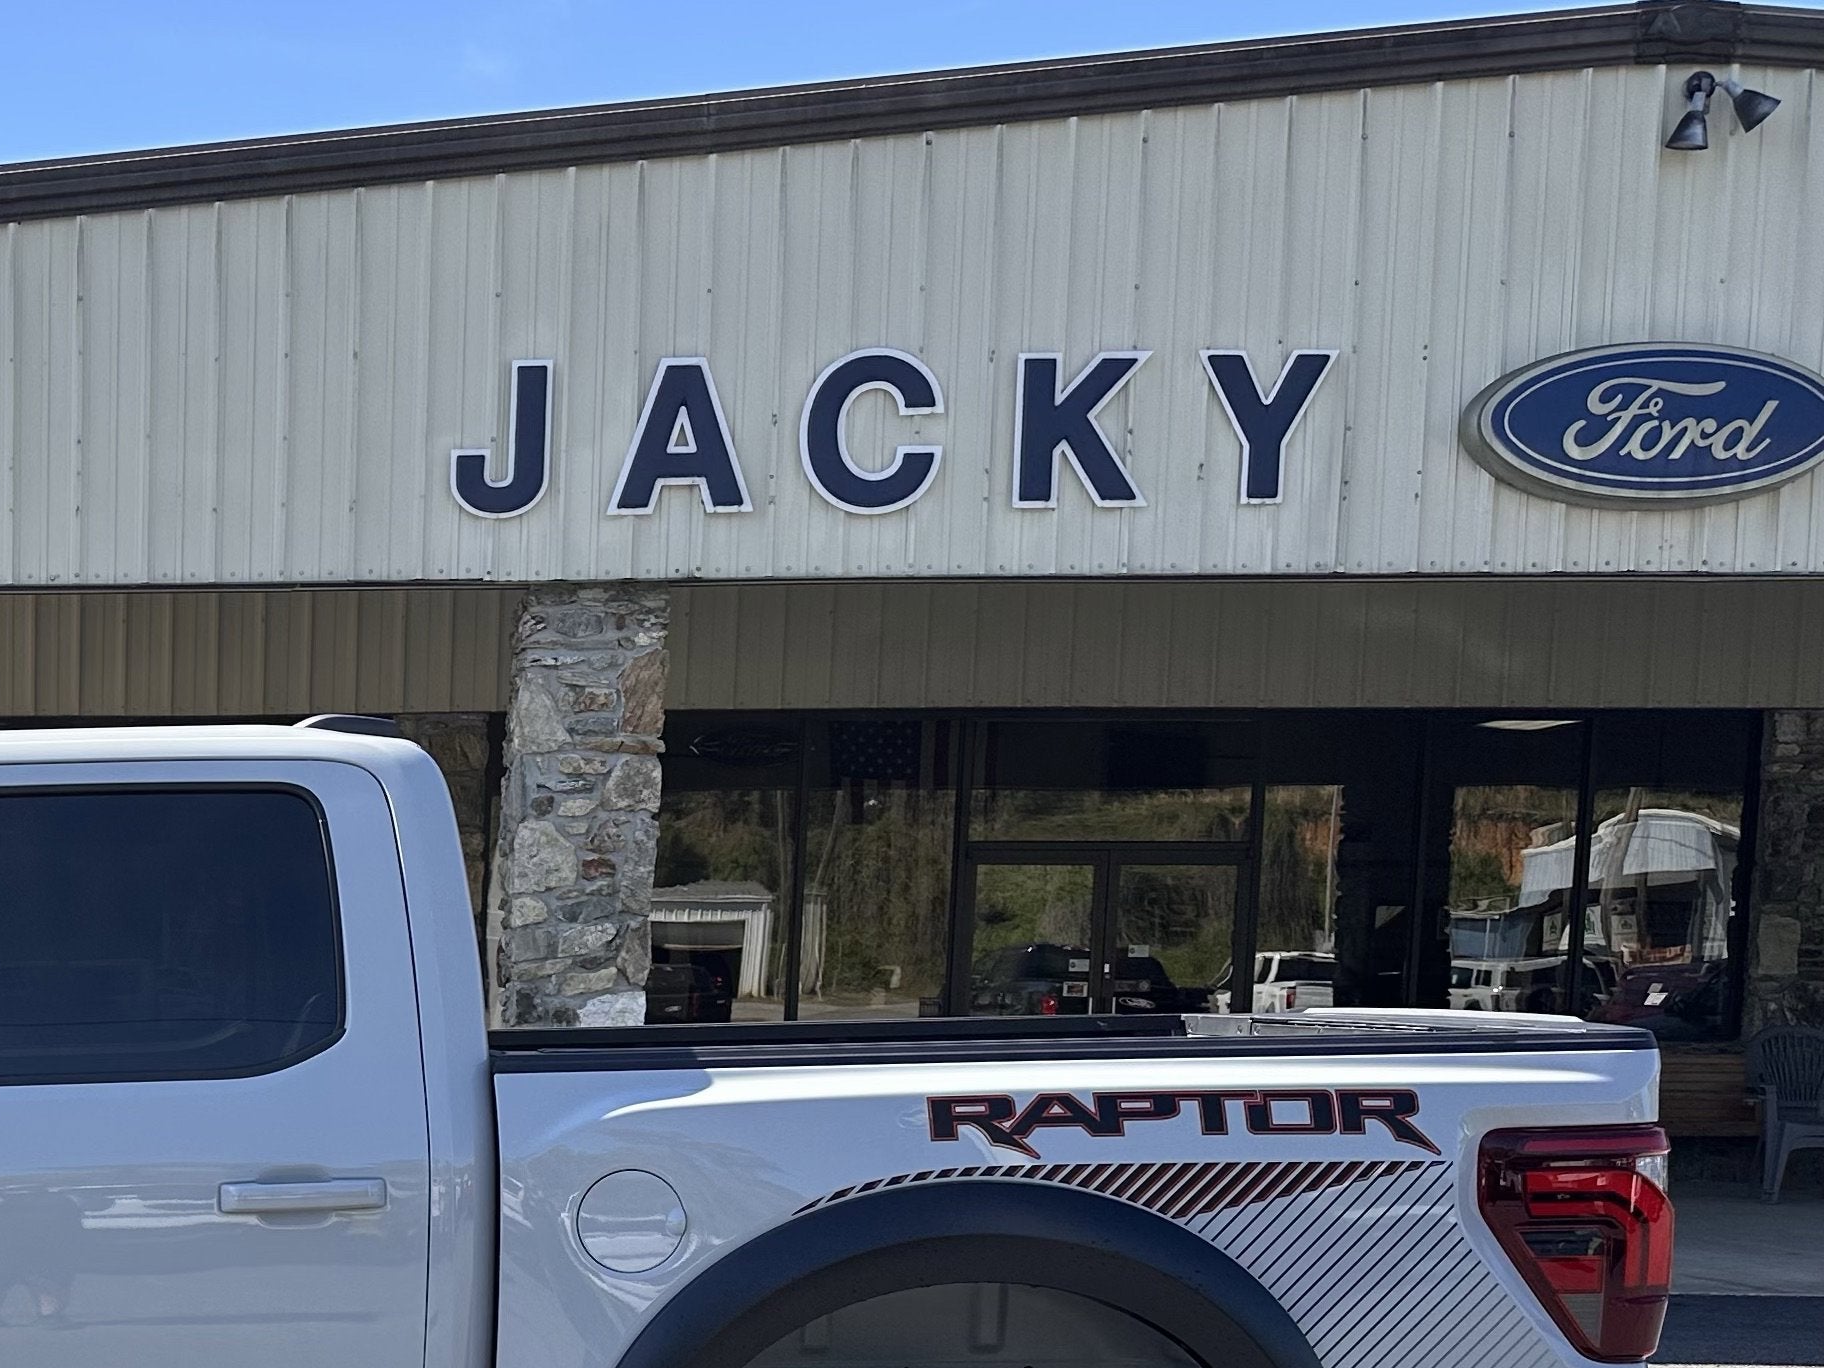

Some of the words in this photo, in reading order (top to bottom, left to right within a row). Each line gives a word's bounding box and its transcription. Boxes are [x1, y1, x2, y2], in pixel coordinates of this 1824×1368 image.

[450, 346, 1340, 518] JACKY
[1562, 376, 1780, 462] Ford
[926, 1088, 1442, 1159] RAPTOR
